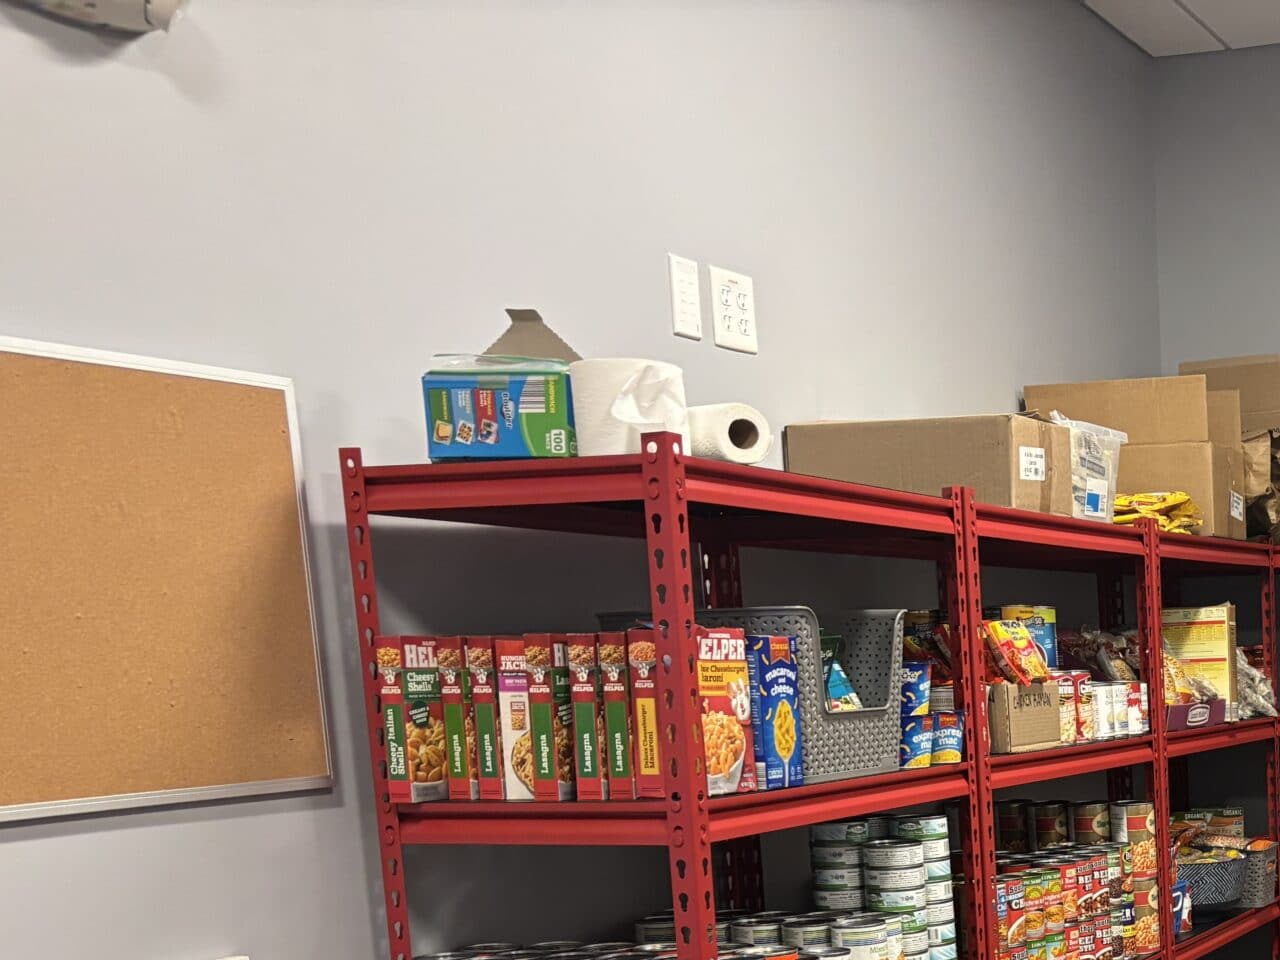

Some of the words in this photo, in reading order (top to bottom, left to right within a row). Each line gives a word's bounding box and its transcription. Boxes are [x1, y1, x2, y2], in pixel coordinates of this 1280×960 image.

[553, 430, 564, 452] 100
[699, 638, 746, 660] ELPER
[406, 672, 435, 684] Cheesy
[765, 668, 796, 682] macaroni
[770, 683, 794, 696] cheese
[388, 708, 396, 738] Italian
[390, 741, 398, 775] Cheesy
[397, 746, 406, 774] Shells
[454, 734, 462, 773] Lasagna
[485, 733, 493, 772] Lasagna
[541, 734, 549, 774] Lasagna
[584, 732, 592, 772] Lasagna
[615, 732, 624, 772] Lasagna
